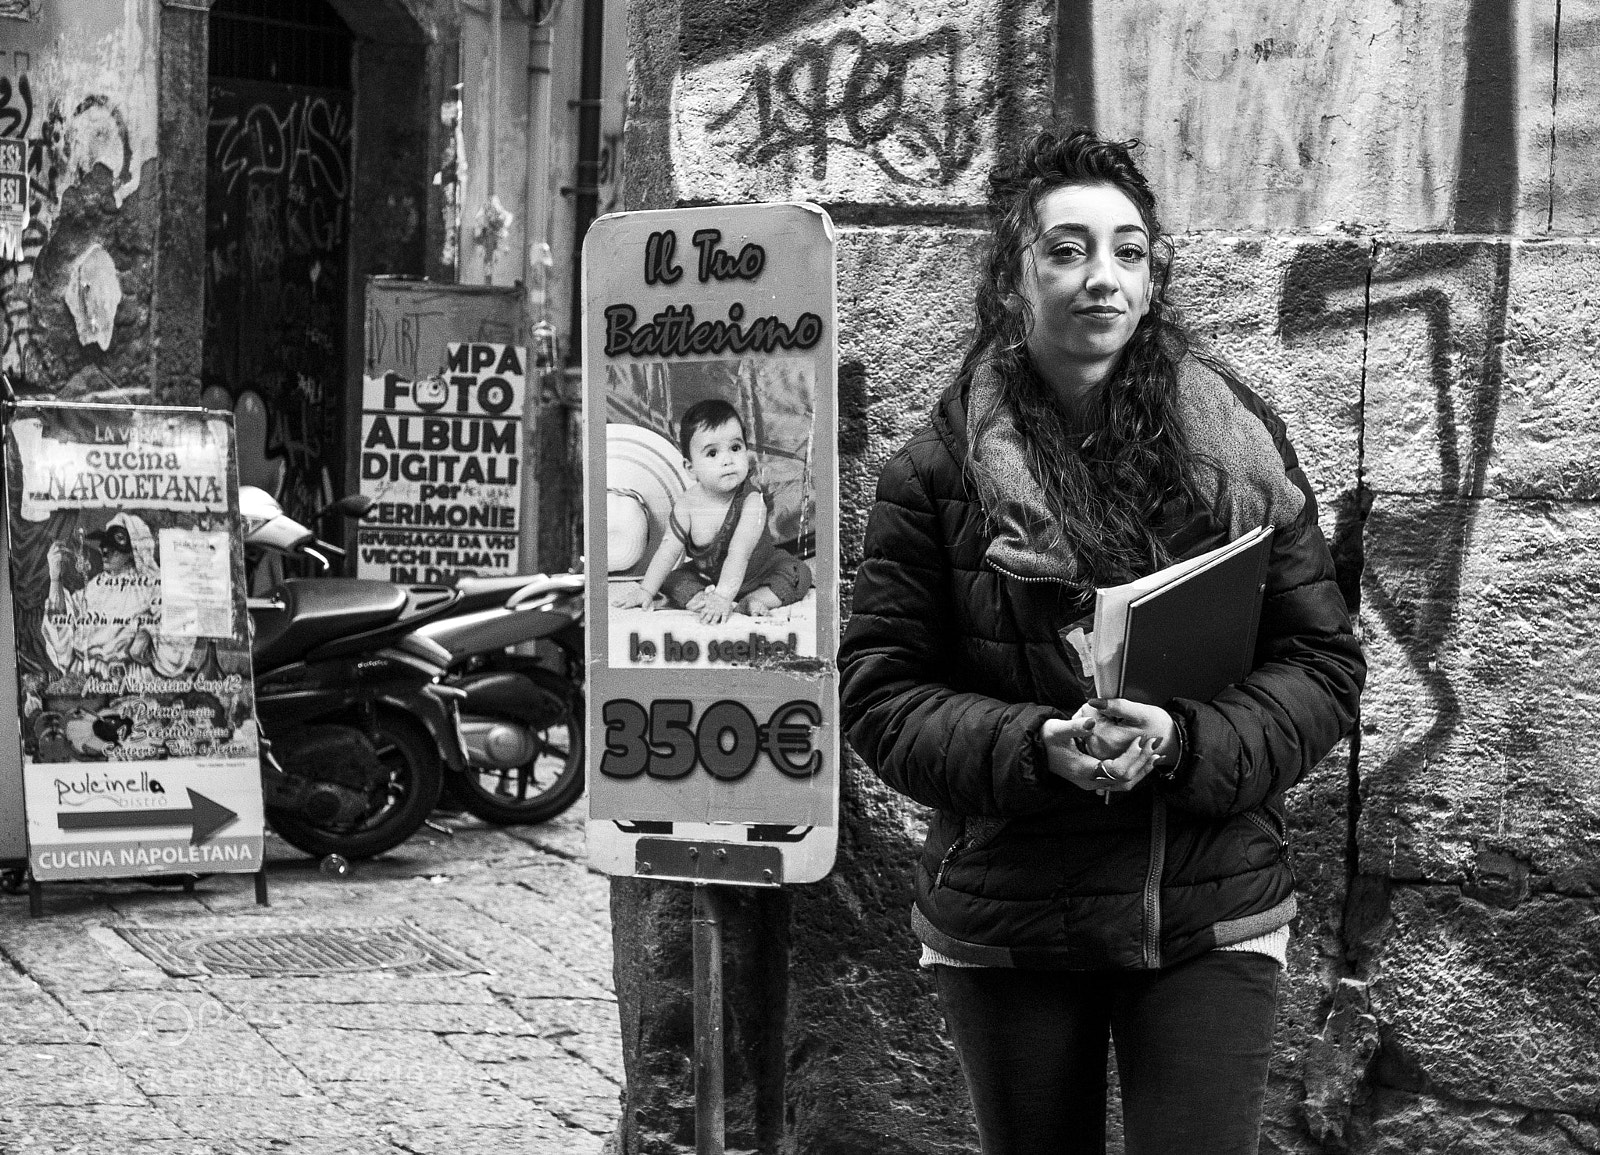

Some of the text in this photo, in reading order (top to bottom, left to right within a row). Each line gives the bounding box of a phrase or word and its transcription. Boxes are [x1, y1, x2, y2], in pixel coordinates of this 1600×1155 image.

[644, 228, 766, 285] Il Tuo
[604, 302, 823, 357] Battesimo
[384, 373, 514, 414] FOTO
[95, 424, 115, 443] LA
[364, 415, 516, 454] ALBUM
[86, 446, 181, 471] cucina
[362, 452, 518, 486] DIGITALI
[49, 466, 222, 503] NAPOLETANA
[420, 484, 461, 502] per
[362, 503, 515, 528] CERIMONIE
[361, 548, 510, 568] VECCHI FILMATI
[664, 632, 700, 663] ho
[600, 698, 823, 782] 350€
[54, 771, 166, 805] pulcinella
[39, 844, 252, 869] CUCINA NAPOLETANA
